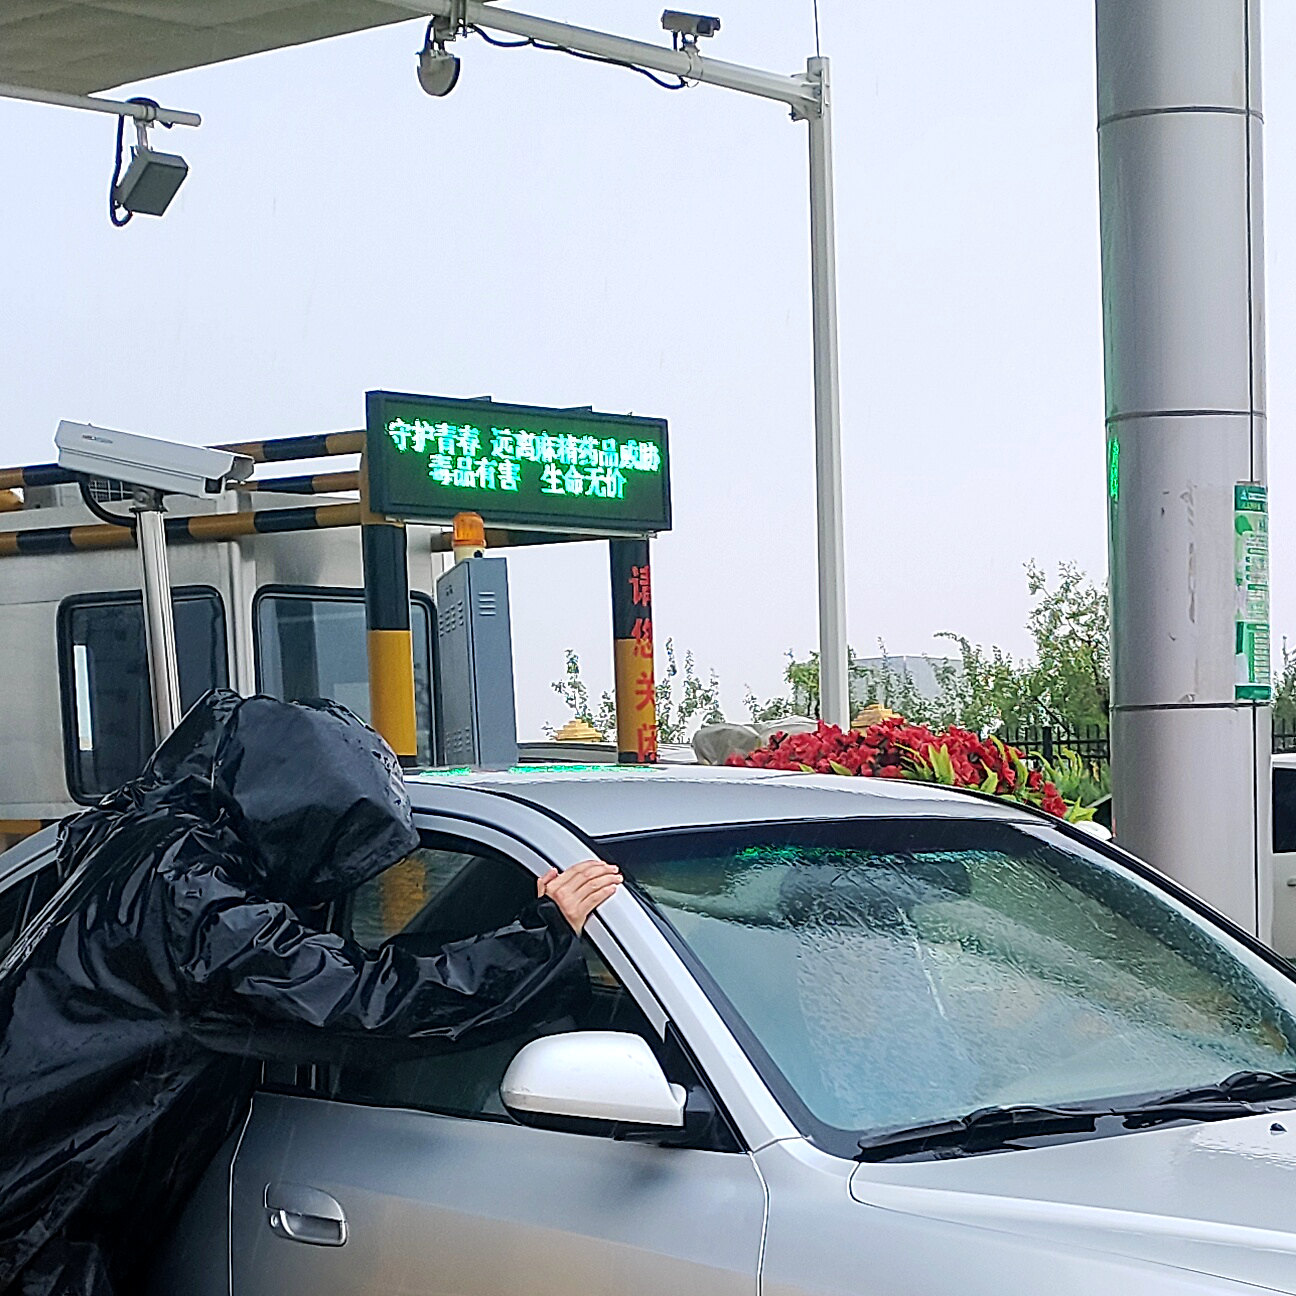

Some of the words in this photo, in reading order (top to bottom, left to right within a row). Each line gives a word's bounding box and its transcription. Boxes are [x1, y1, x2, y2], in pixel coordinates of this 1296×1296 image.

[388, 417, 481, 454] 守护青春
[428, 453, 521, 491] 毒品有害
[540, 463, 627, 498] 生命无价
